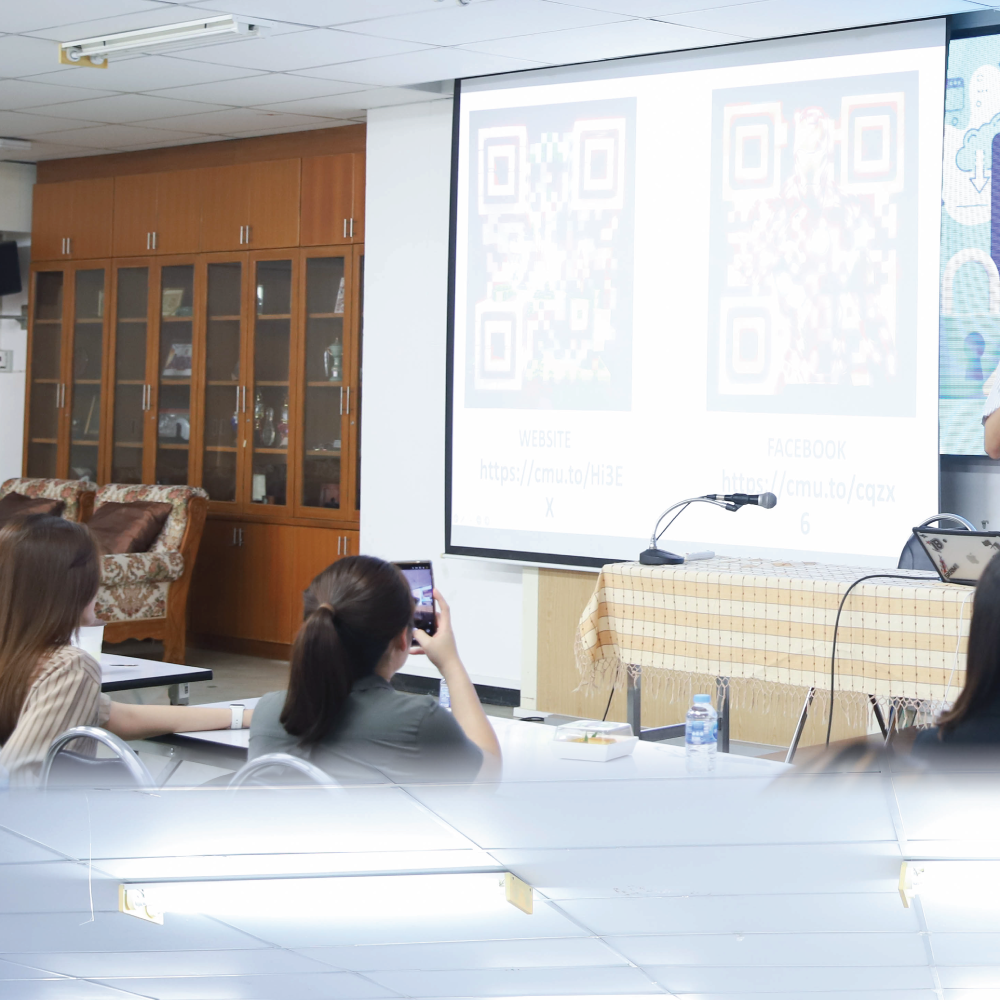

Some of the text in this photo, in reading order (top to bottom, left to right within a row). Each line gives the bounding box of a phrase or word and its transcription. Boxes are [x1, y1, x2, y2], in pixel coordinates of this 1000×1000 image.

[518, 429, 572, 449] WEBSITE
[766, 437, 848, 461] FACEBOOK
[479, 459, 624, 488] https://cmu.to/Hi3E
[545, 496, 555, 518] X
[799, 512, 811, 535] 6
